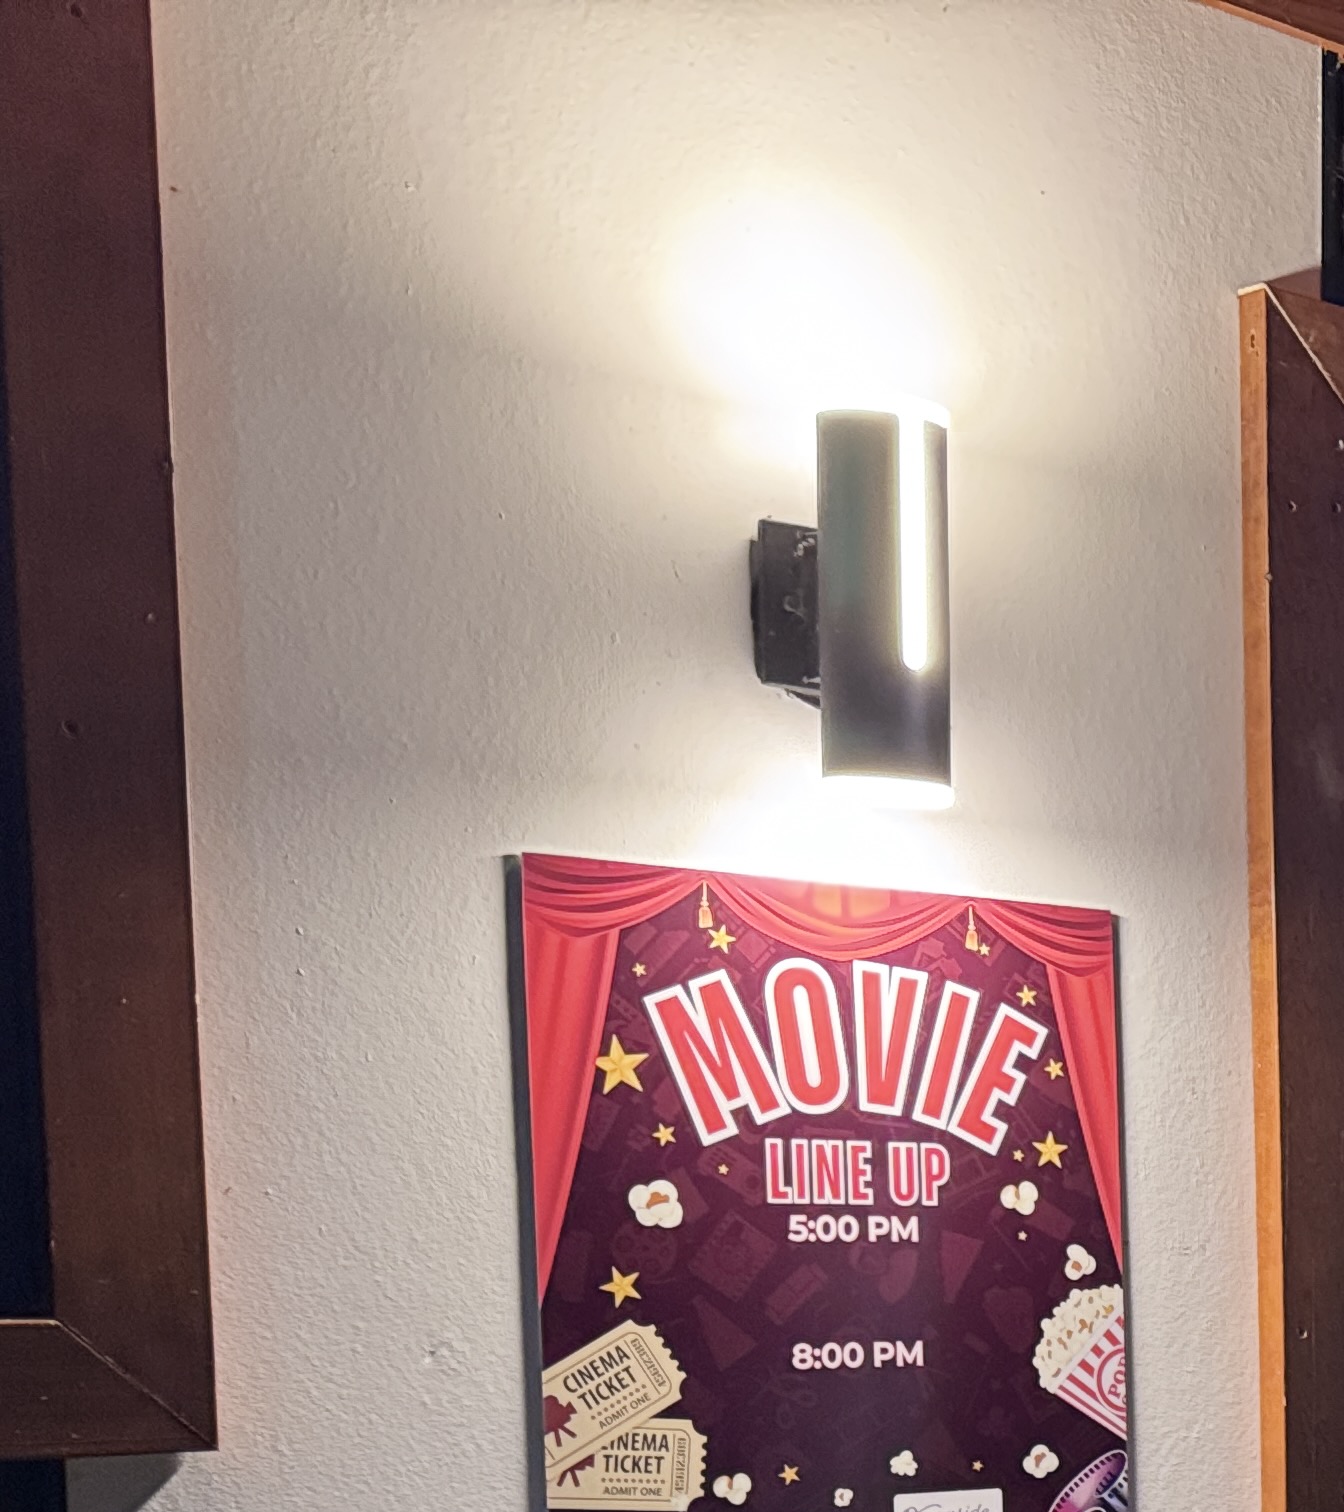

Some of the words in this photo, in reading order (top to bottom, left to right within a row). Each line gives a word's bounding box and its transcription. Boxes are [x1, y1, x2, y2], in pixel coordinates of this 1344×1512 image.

[643, 957, 1049, 1157] MOVIE
[765, 1138, 874, 1206] LINE
[888, 1142, 951, 1207] UP
[787, 1214, 860, 1243] 5:00
[867, 1215, 920, 1243] PM
[563, 1344, 631, 1394] CINEMA
[791, 1341, 865, 1371] 8:00
[873, 1339, 925, 1368] PM
[577, 1365, 638, 1411] TICKET
[599, 1404, 630, 1430] ADMIT
[631, 1392, 652, 1411] ONE
[600, 1432, 670, 1453] INEMA
[603, 1454, 665, 1475] TICKET
[602, 1486, 637, 1497] ADMIT
[640, 1486, 663, 1497] ONE
